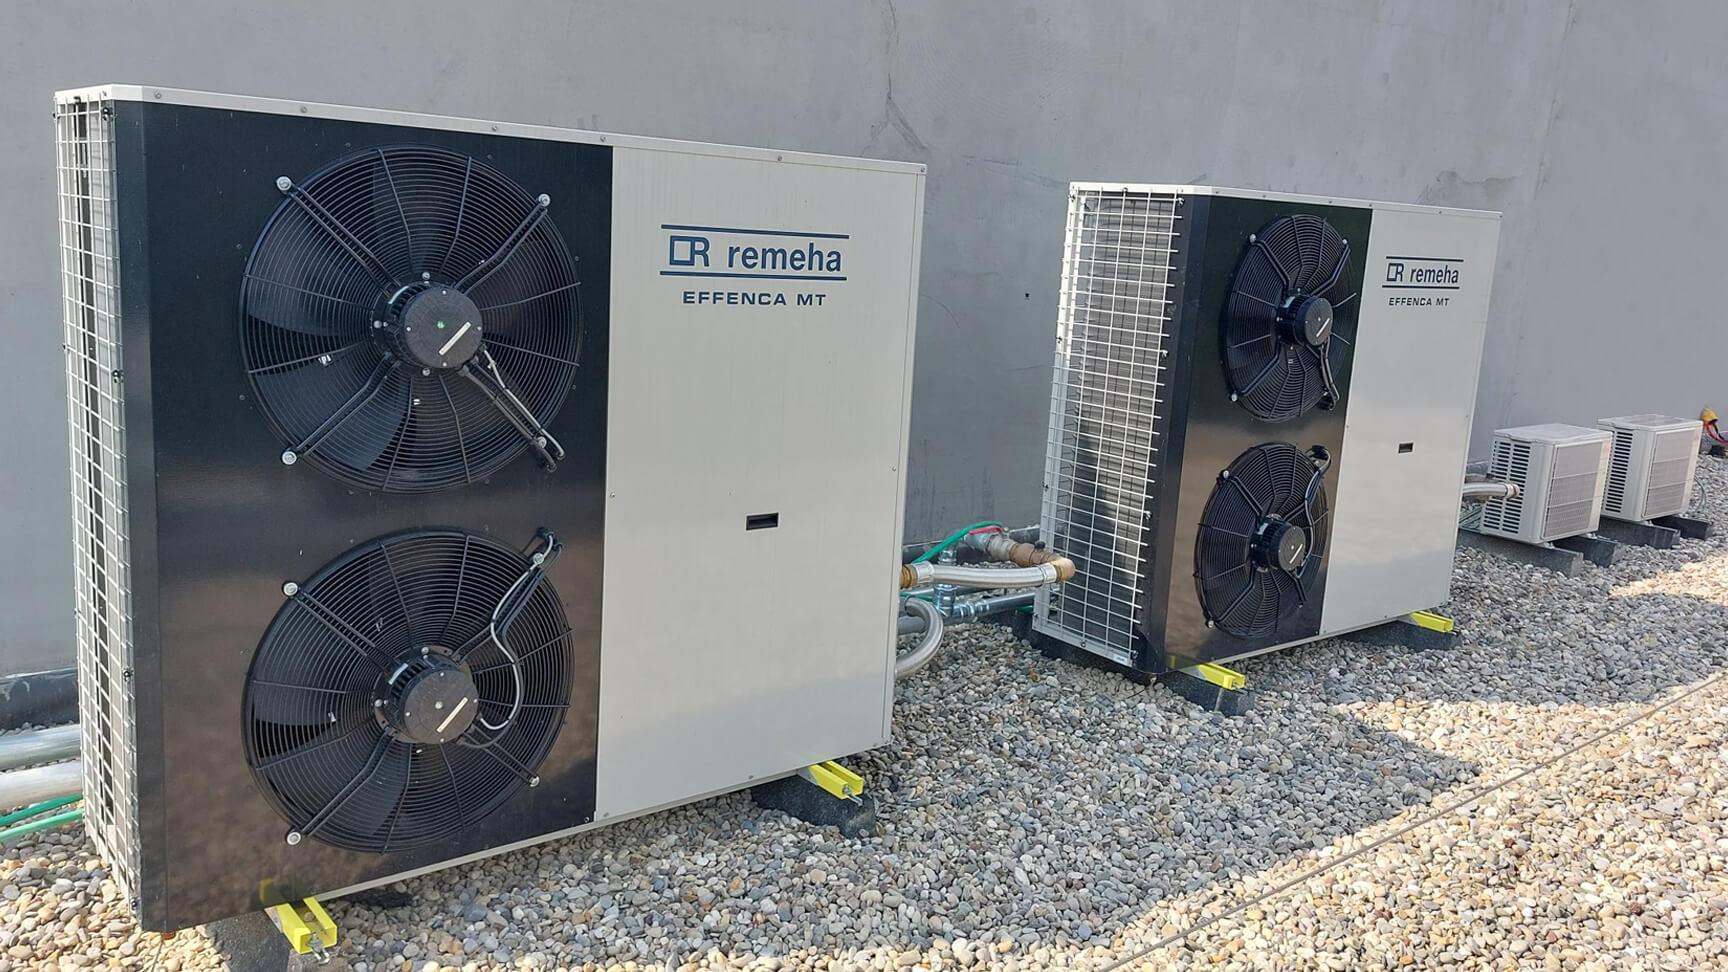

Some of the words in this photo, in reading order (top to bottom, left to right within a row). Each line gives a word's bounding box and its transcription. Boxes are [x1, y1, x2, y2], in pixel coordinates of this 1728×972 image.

[728, 242, 841, 273] remeha
[1409, 264, 1460, 284] remeha
[683, 291, 787, 306] EFFENCA
[796, 293, 827, 306] MT
[1388, 297, 1433, 307] EFFENCA
[1435, 297, 1450, 307] MT
